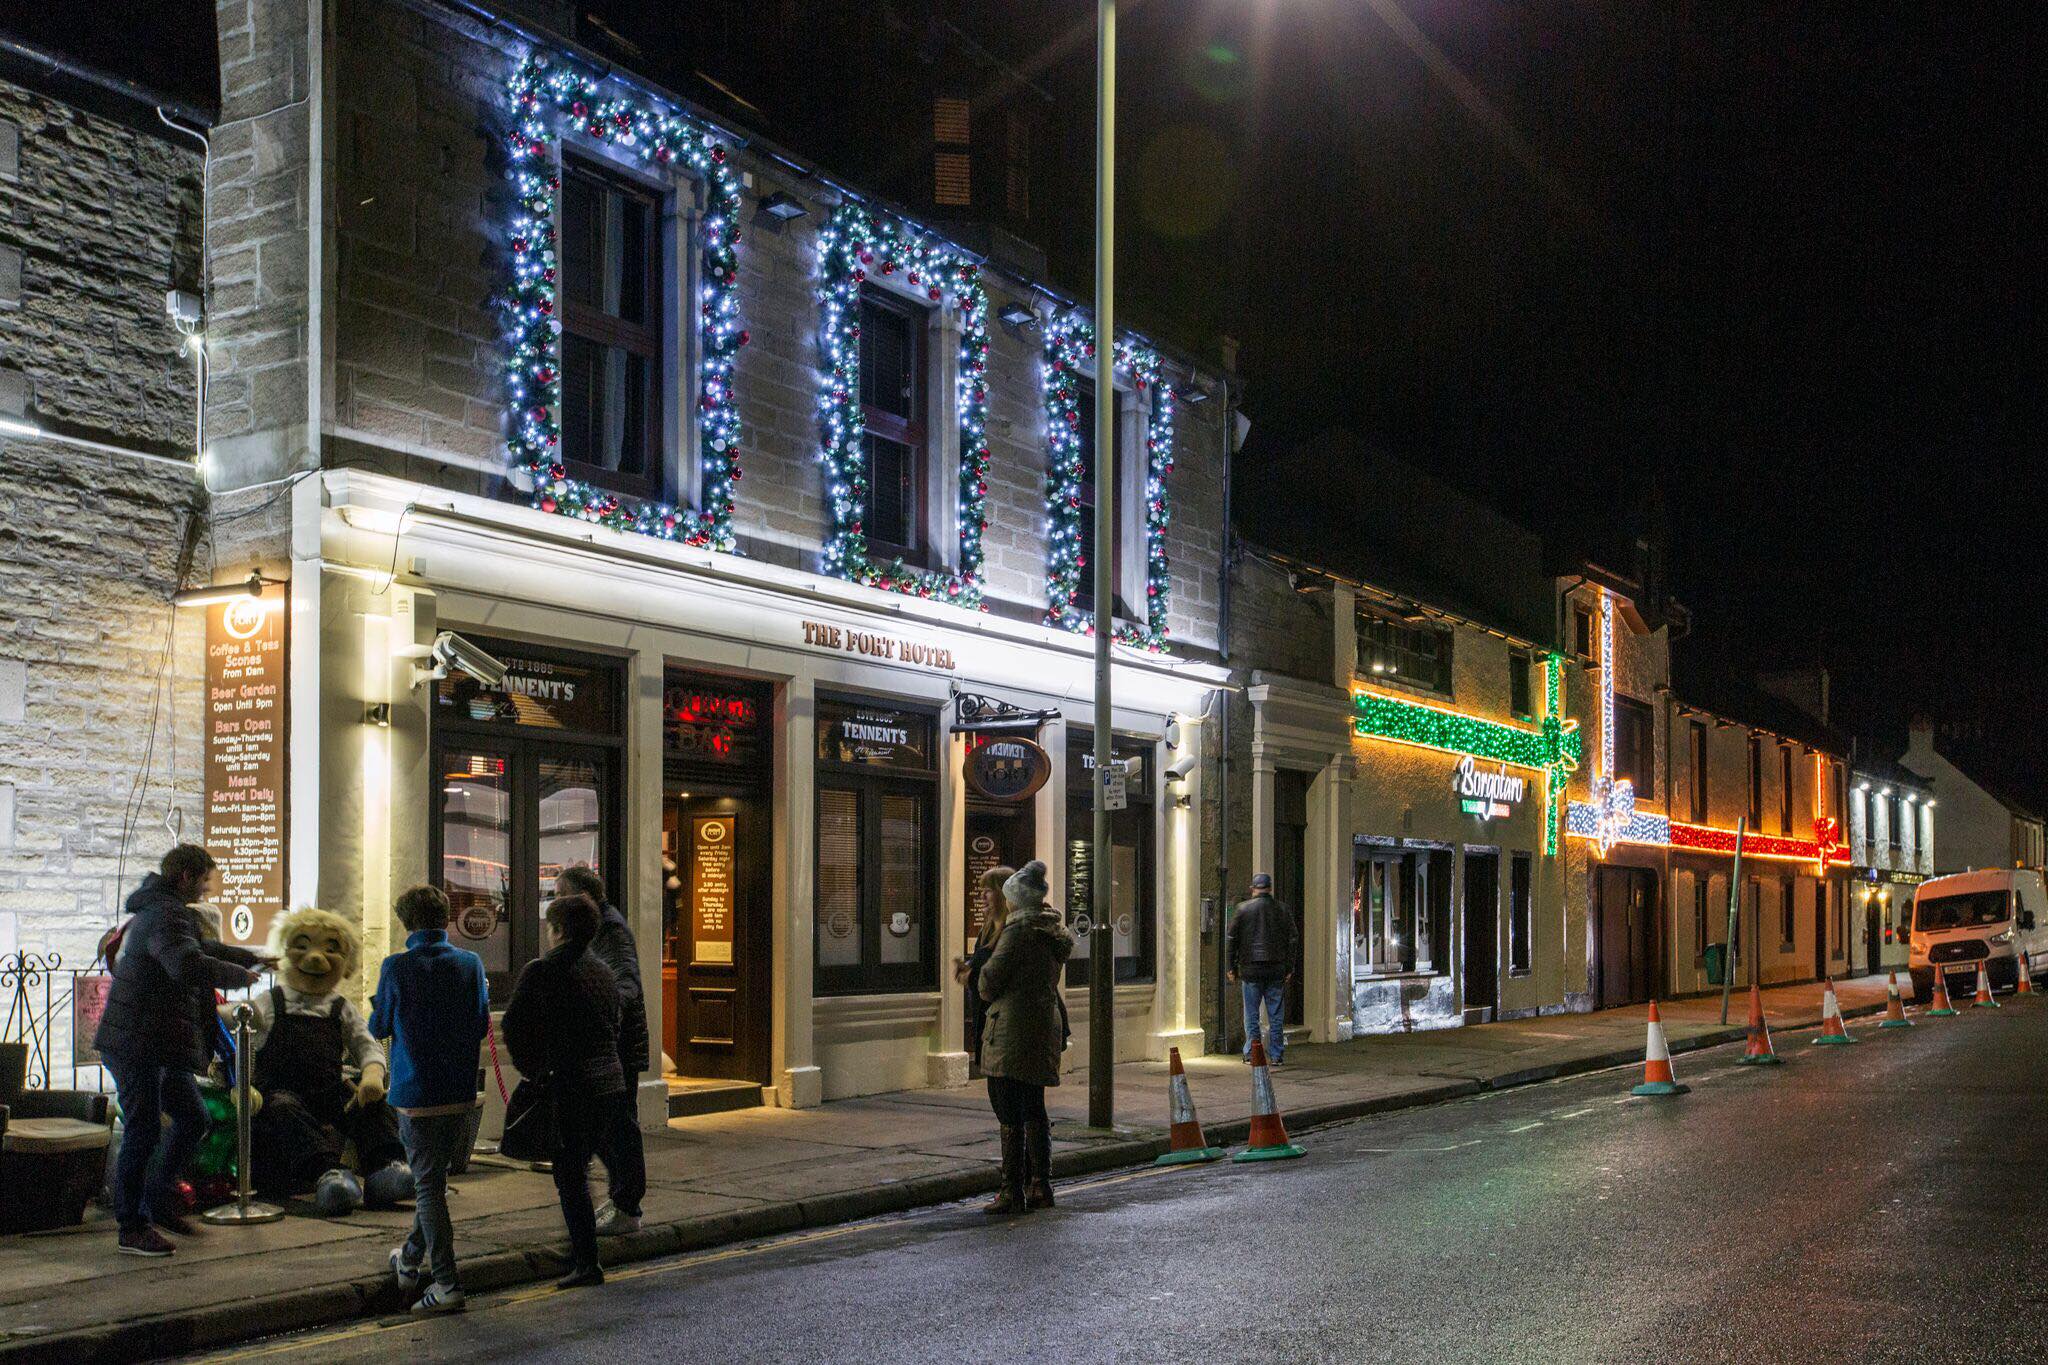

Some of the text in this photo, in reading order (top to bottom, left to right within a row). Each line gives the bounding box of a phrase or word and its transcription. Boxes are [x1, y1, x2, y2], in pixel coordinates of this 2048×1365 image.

[209, 640, 279, 657] Coffee & Teas
[802, 620, 956, 670] THE FORT HOTEL
[225, 655, 262, 668] Scones
[223, 668, 242, 679] From
[211, 683, 276, 700] Beer Garden
[213, 702, 233, 713] Open
[255, 698, 273, 709] 9pm
[215, 719, 271, 733] Bars Open
[842, 720, 908, 745] TENNENT'S
[213, 733, 273, 745] Sunday-Thursday
[245, 743, 259, 752] 1am
[214, 752, 271, 764] Friday-Saturday
[243, 762, 259, 770] 2am
[228, 775, 257, 787] Meals
[1460, 755, 1523, 821] Borgotaro
[212, 788, 275, 802] Served Daily
[210, 825, 241, 836] Saturday
[206, 838, 232, 849] Sunday
[222, 871, 263, 890] Borgotaro
